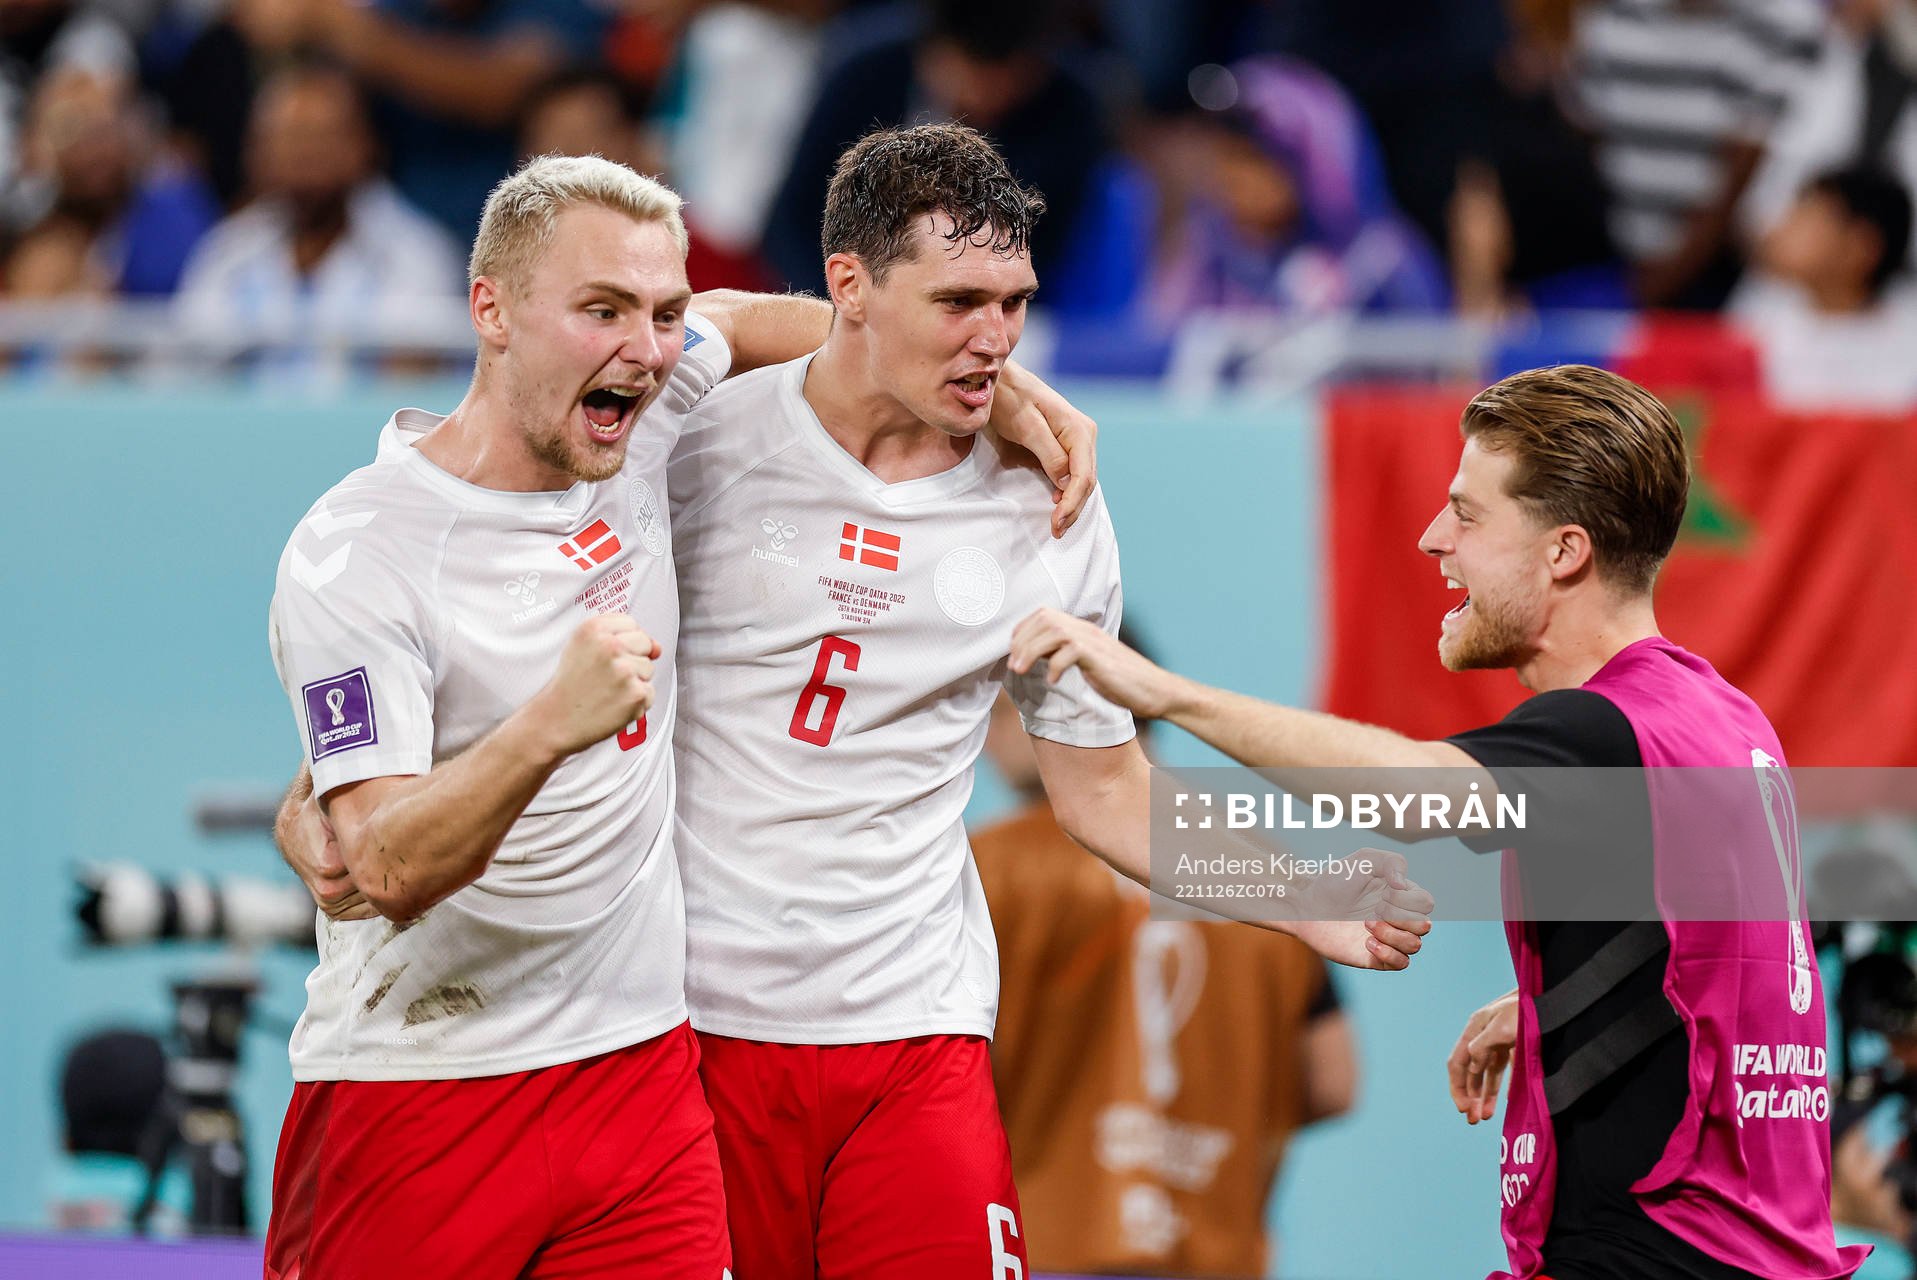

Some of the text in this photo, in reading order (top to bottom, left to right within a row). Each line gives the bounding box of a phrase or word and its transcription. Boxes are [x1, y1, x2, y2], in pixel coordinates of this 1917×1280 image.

[751, 544, 800, 568] hummel
[585, 584, 599, 598] WORLD
[600, 578, 609, 589] CUP
[609, 569, 623, 583] QATAR
[622, 561, 634, 575] 2022
[818, 576, 906, 604] FIFA WORLD CUP QATAR 2022
[585, 595, 604, 610] FRANCE
[608, 579, 631, 597] DENMARK
[828, 590, 851, 604] FRANCE
[860, 598, 891, 611] DENMARK
[511, 596, 558, 624] hummel
[838, 604, 877, 617] 26TH NOVEMBER
[841, 613, 862, 623] STADIUM
[788, 635, 861, 747] 6
[329, 725, 350, 736] WORLD
[350, 722, 363, 730] CUP
[1733, 1044, 1827, 1077] IFA WORLD
[986, 1203, 1023, 1280] 6
